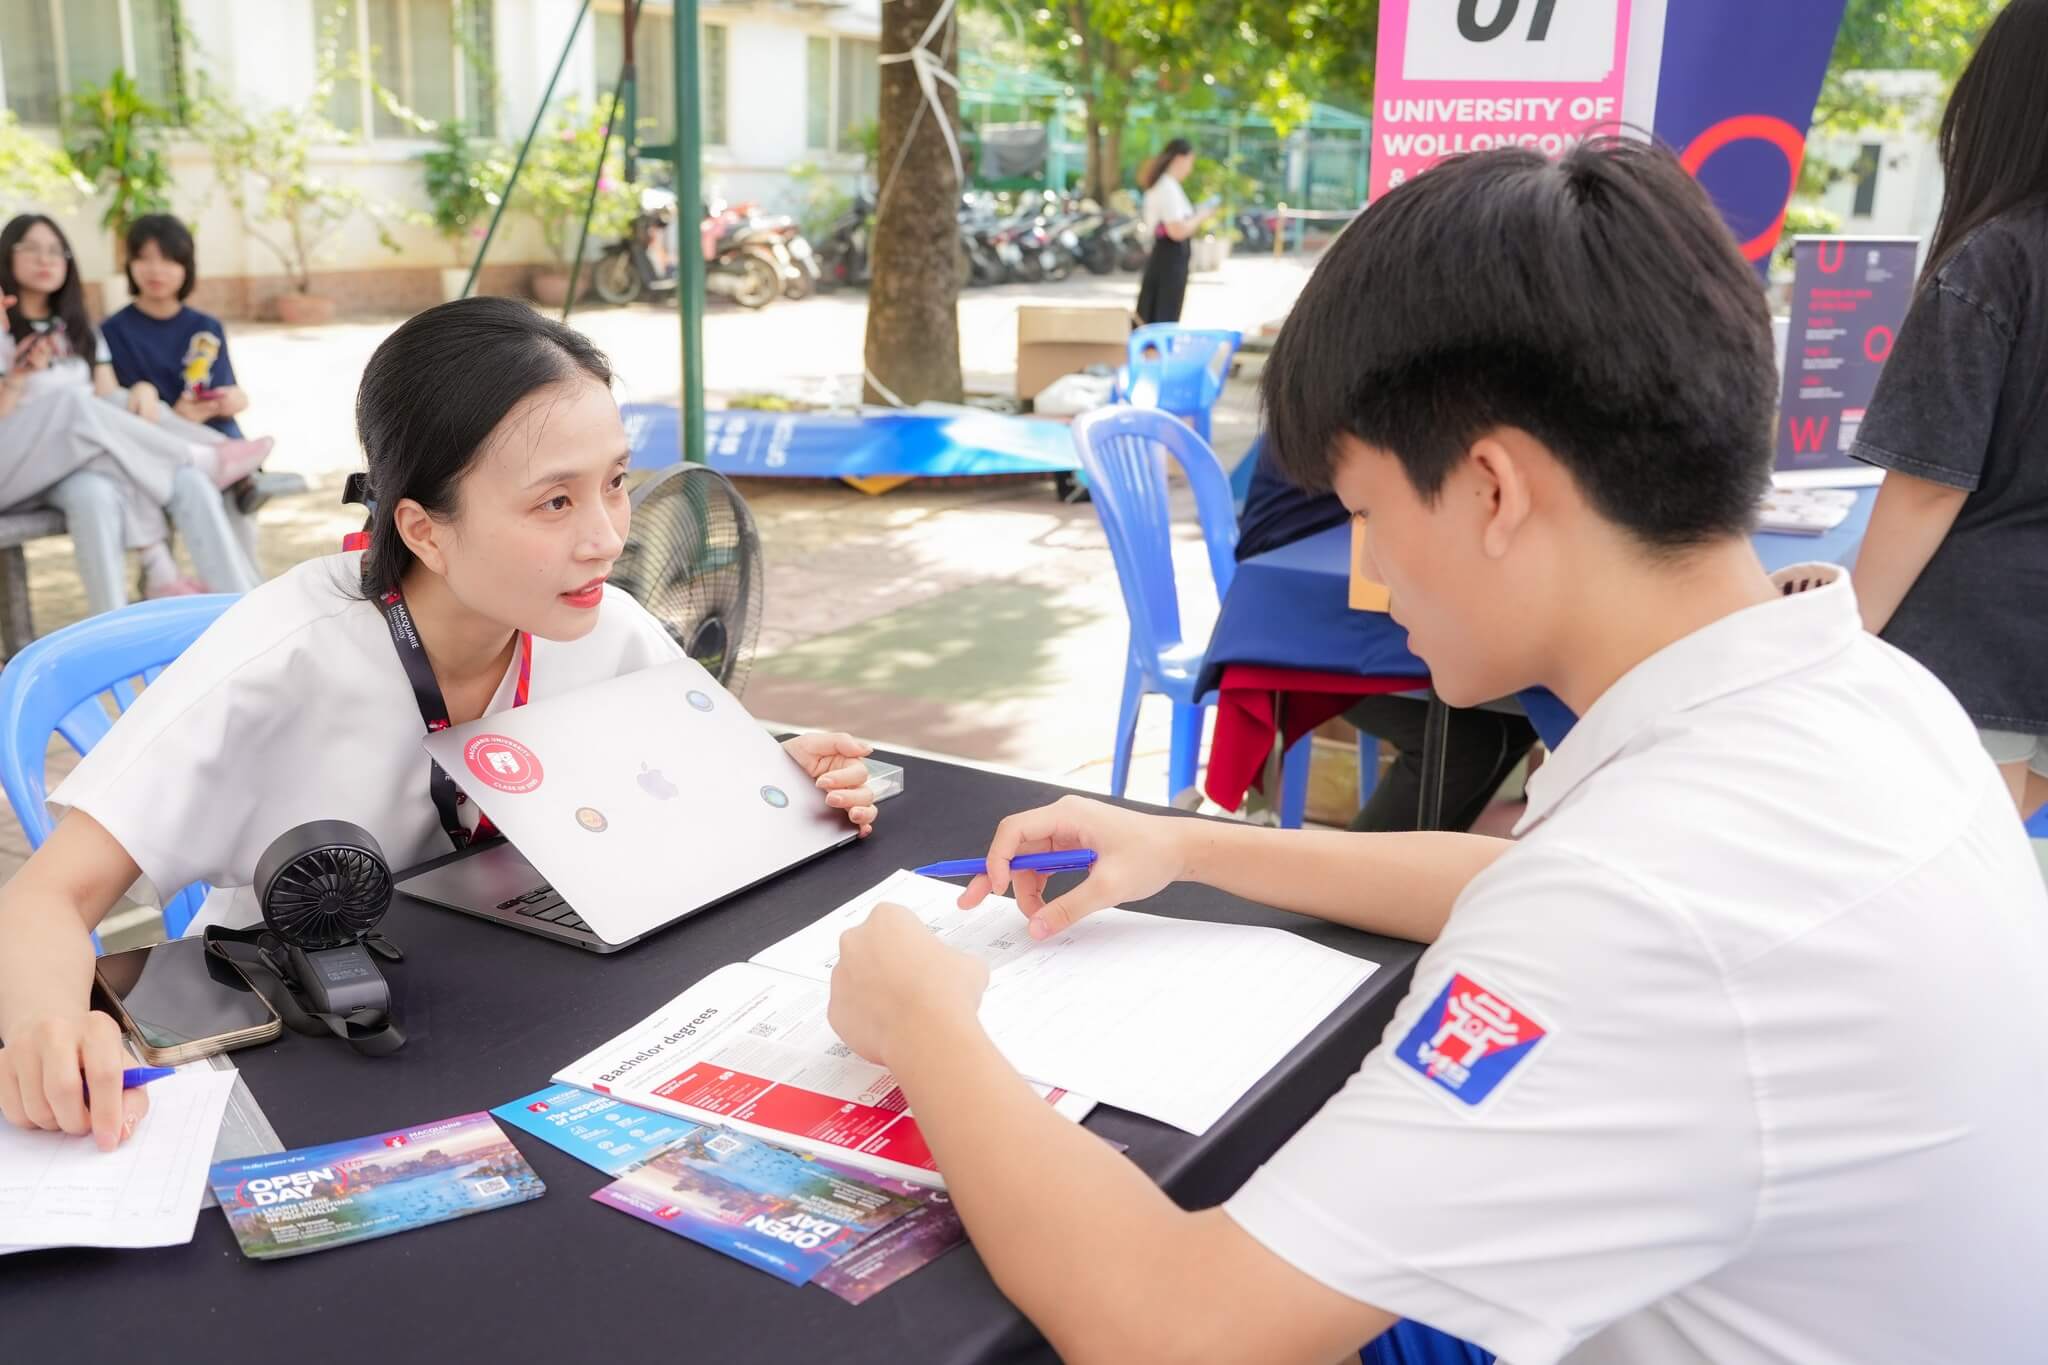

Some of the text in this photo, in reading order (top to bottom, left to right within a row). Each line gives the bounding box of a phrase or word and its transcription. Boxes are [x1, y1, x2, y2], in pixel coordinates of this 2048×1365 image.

[1382, 97, 1615, 122] UNIVERSITY OF
[1789, 416, 1830, 454] W
[390, 606, 406, 640] University
[396, 604, 420, 649] MACQUARIE
[600, 1043, 665, 1083] Bachelor
[664, 1006, 719, 1045] degrees
[247, 1168, 335, 1193] OPEN
[254, 1183, 314, 1206] DAY
[743, 1214, 821, 1249] OPEN
[780, 1212, 841, 1238] DAY
